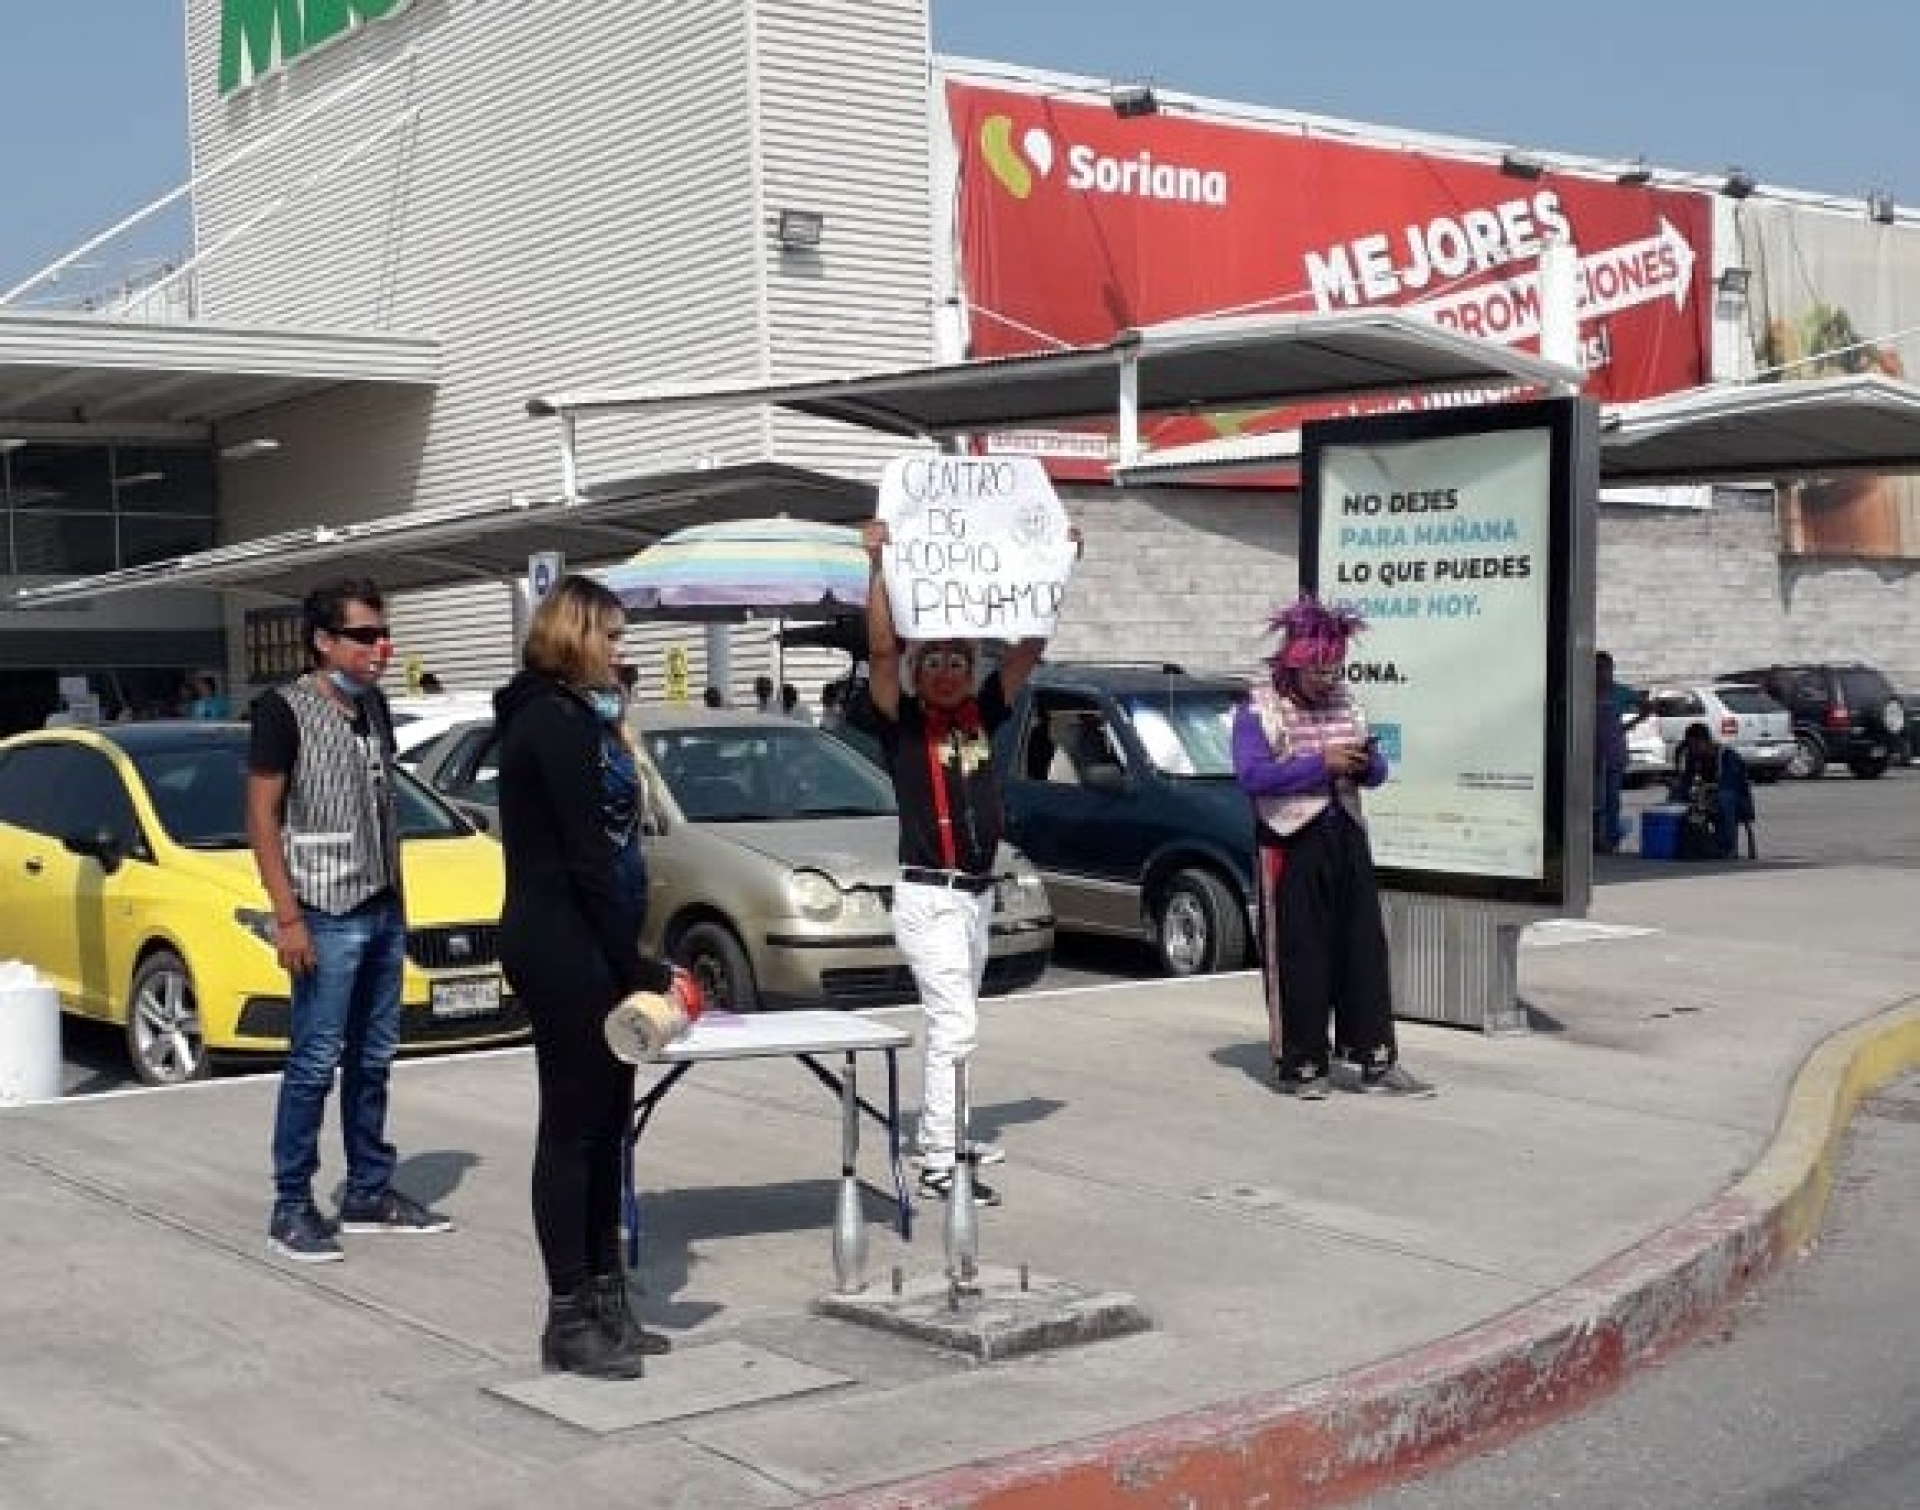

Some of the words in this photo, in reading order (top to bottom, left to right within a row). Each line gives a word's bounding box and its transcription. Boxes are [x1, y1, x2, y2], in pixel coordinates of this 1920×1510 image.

[1067, 144, 1228, 206] Soriana
[1303, 191, 1572, 313] MEJORES
[901, 458, 1016, 502] CENTRO
[1343, 494, 1382, 516] NO
[1389, 488, 1459, 514] DEJES
[1340, 526, 1408, 547] PARA
[1413, 515, 1519, 545] MAÑANA
[1337, 562, 1372, 583] LO
[1378, 561, 1429, 588] QUE
[1434, 555, 1532, 582] PUEDES
[1426, 594, 1482, 617] HOY.
